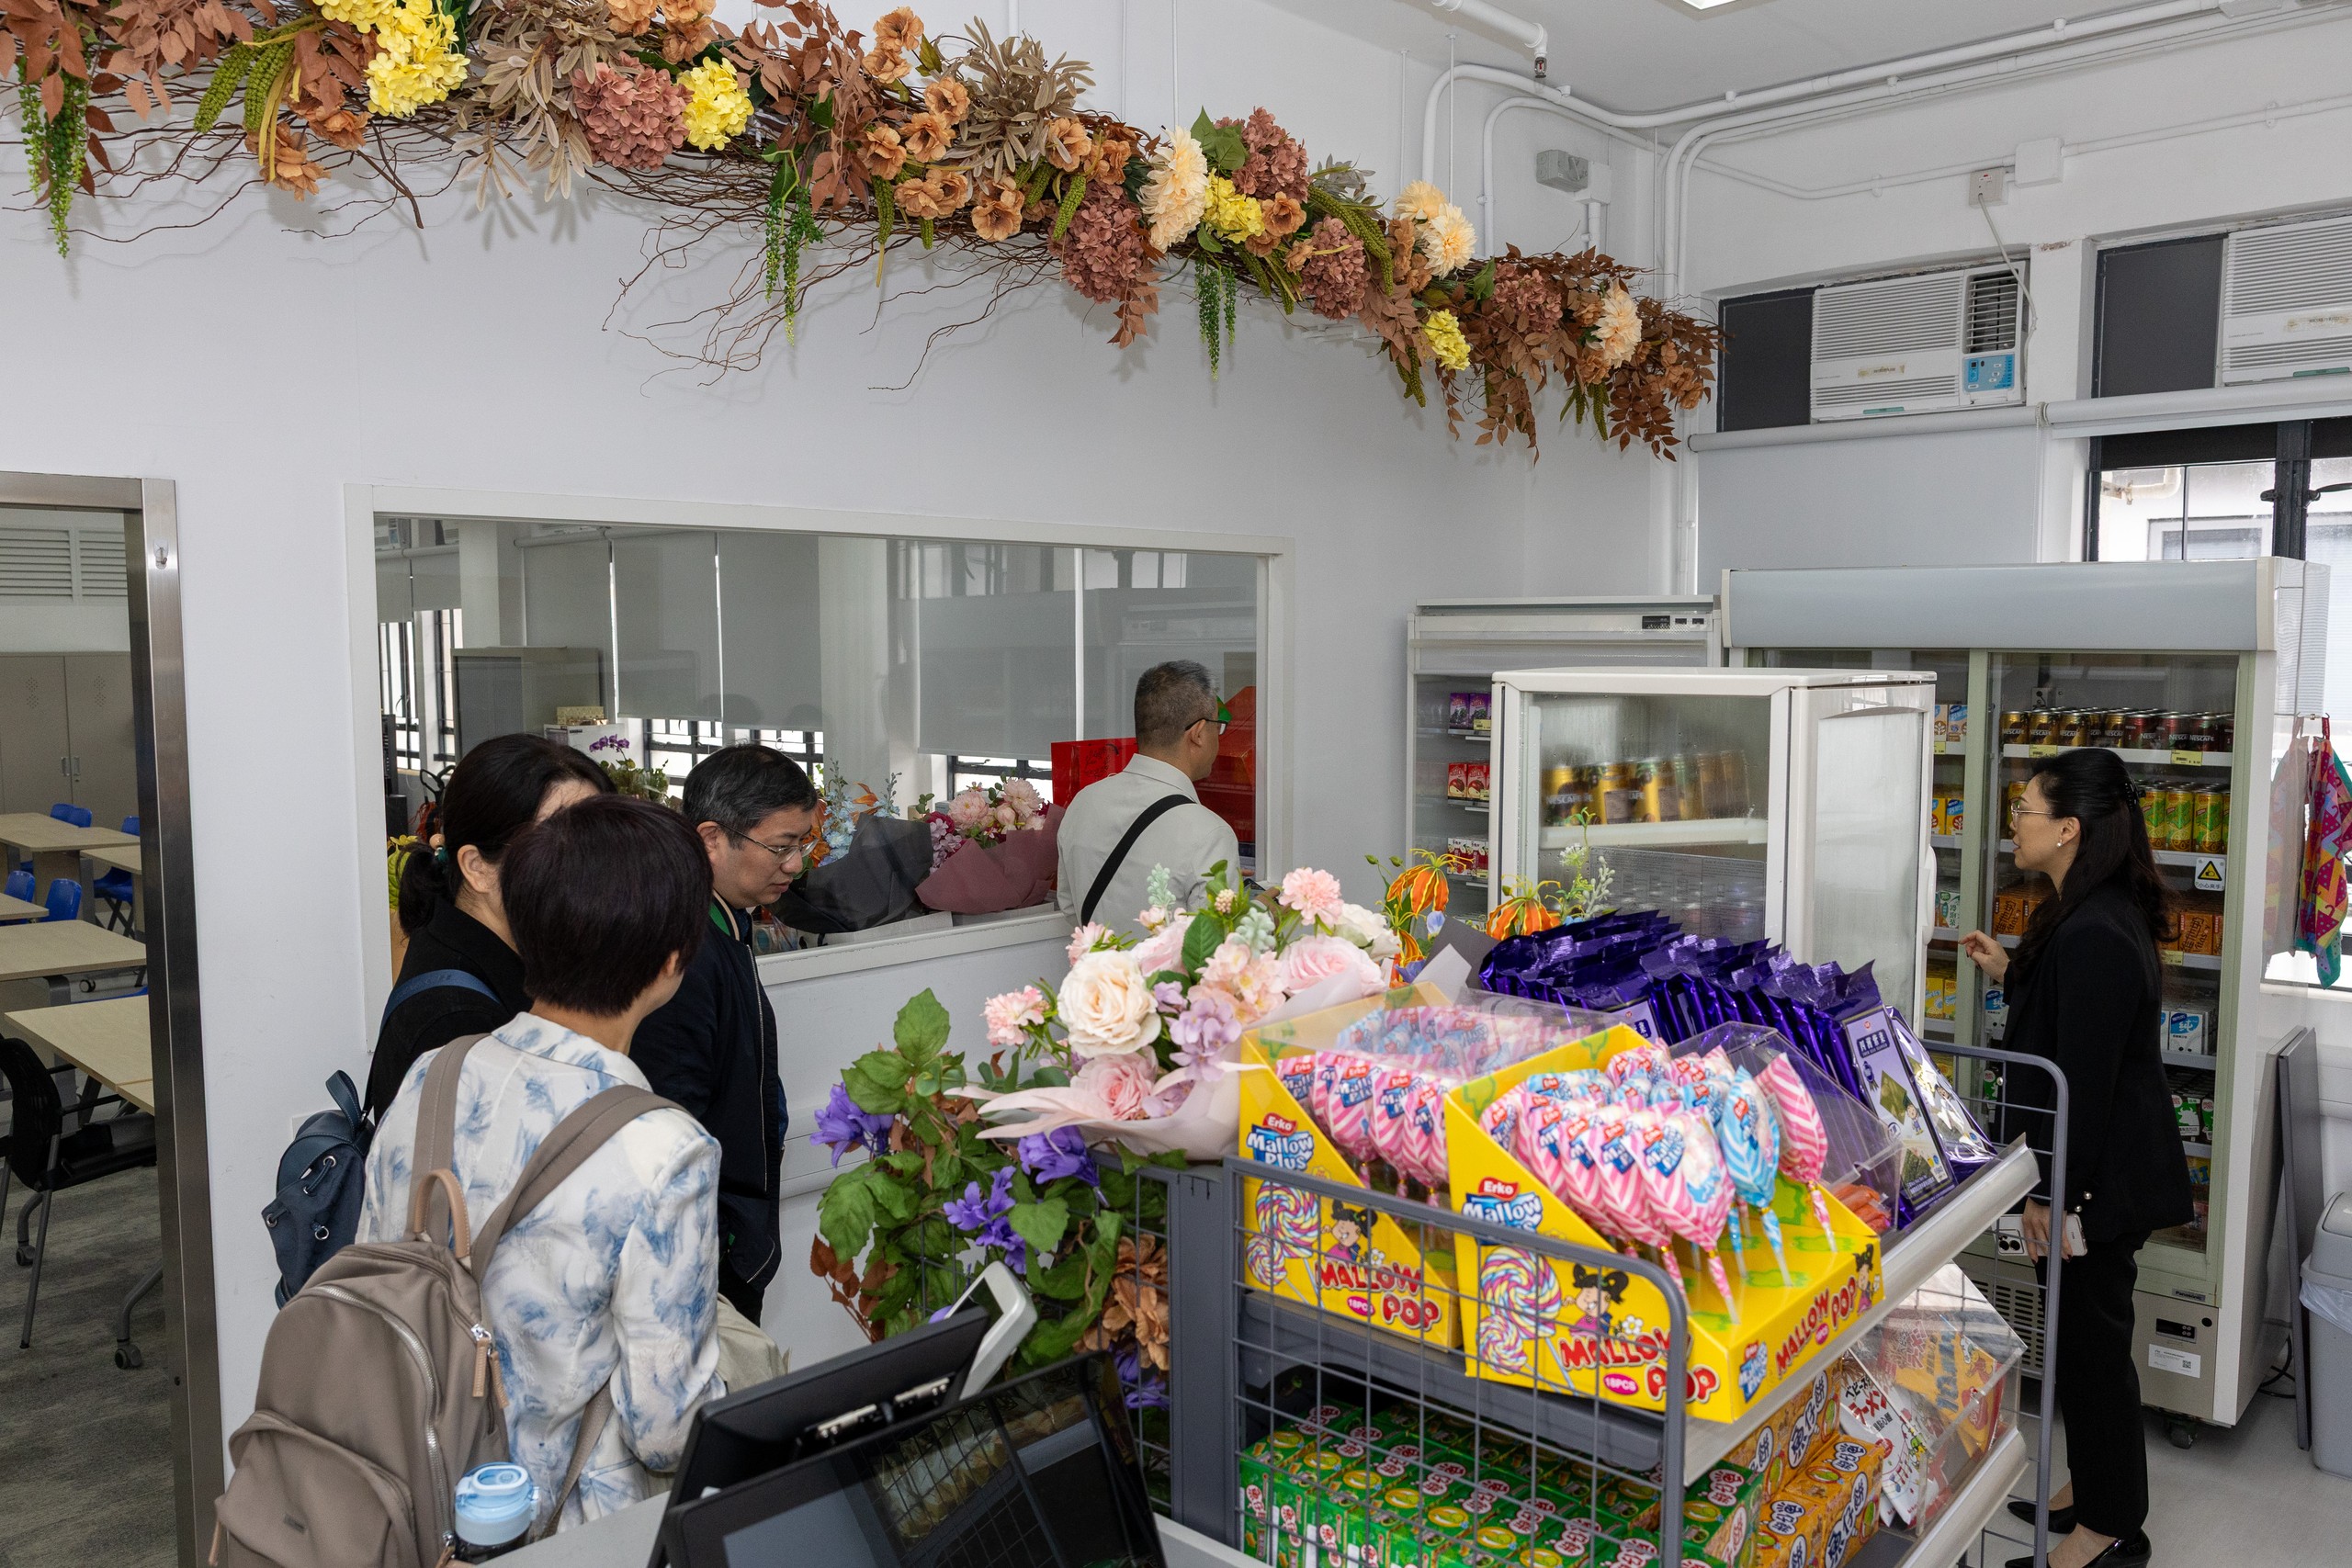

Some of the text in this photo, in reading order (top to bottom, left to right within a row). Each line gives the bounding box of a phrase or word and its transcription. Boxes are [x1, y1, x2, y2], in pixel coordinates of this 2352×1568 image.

[1267, 1114, 1294, 1131] Erko
[1247, 1131, 1314, 1155] Mallow
[1265, 1151, 1308, 1171] Plus
[1484, 1180, 1515, 1195] Erko
[1462, 1195, 1543, 1225] Mallow
[1314, 1259, 1423, 1296] MALLOW
[2175, 1290, 2203, 1301] Panasonic
[1381, 1292, 1442, 1331] POP
[1776, 1276, 1857, 1380] MALLOW POP
[1605, 1376, 1637, 1392] 18PCS
